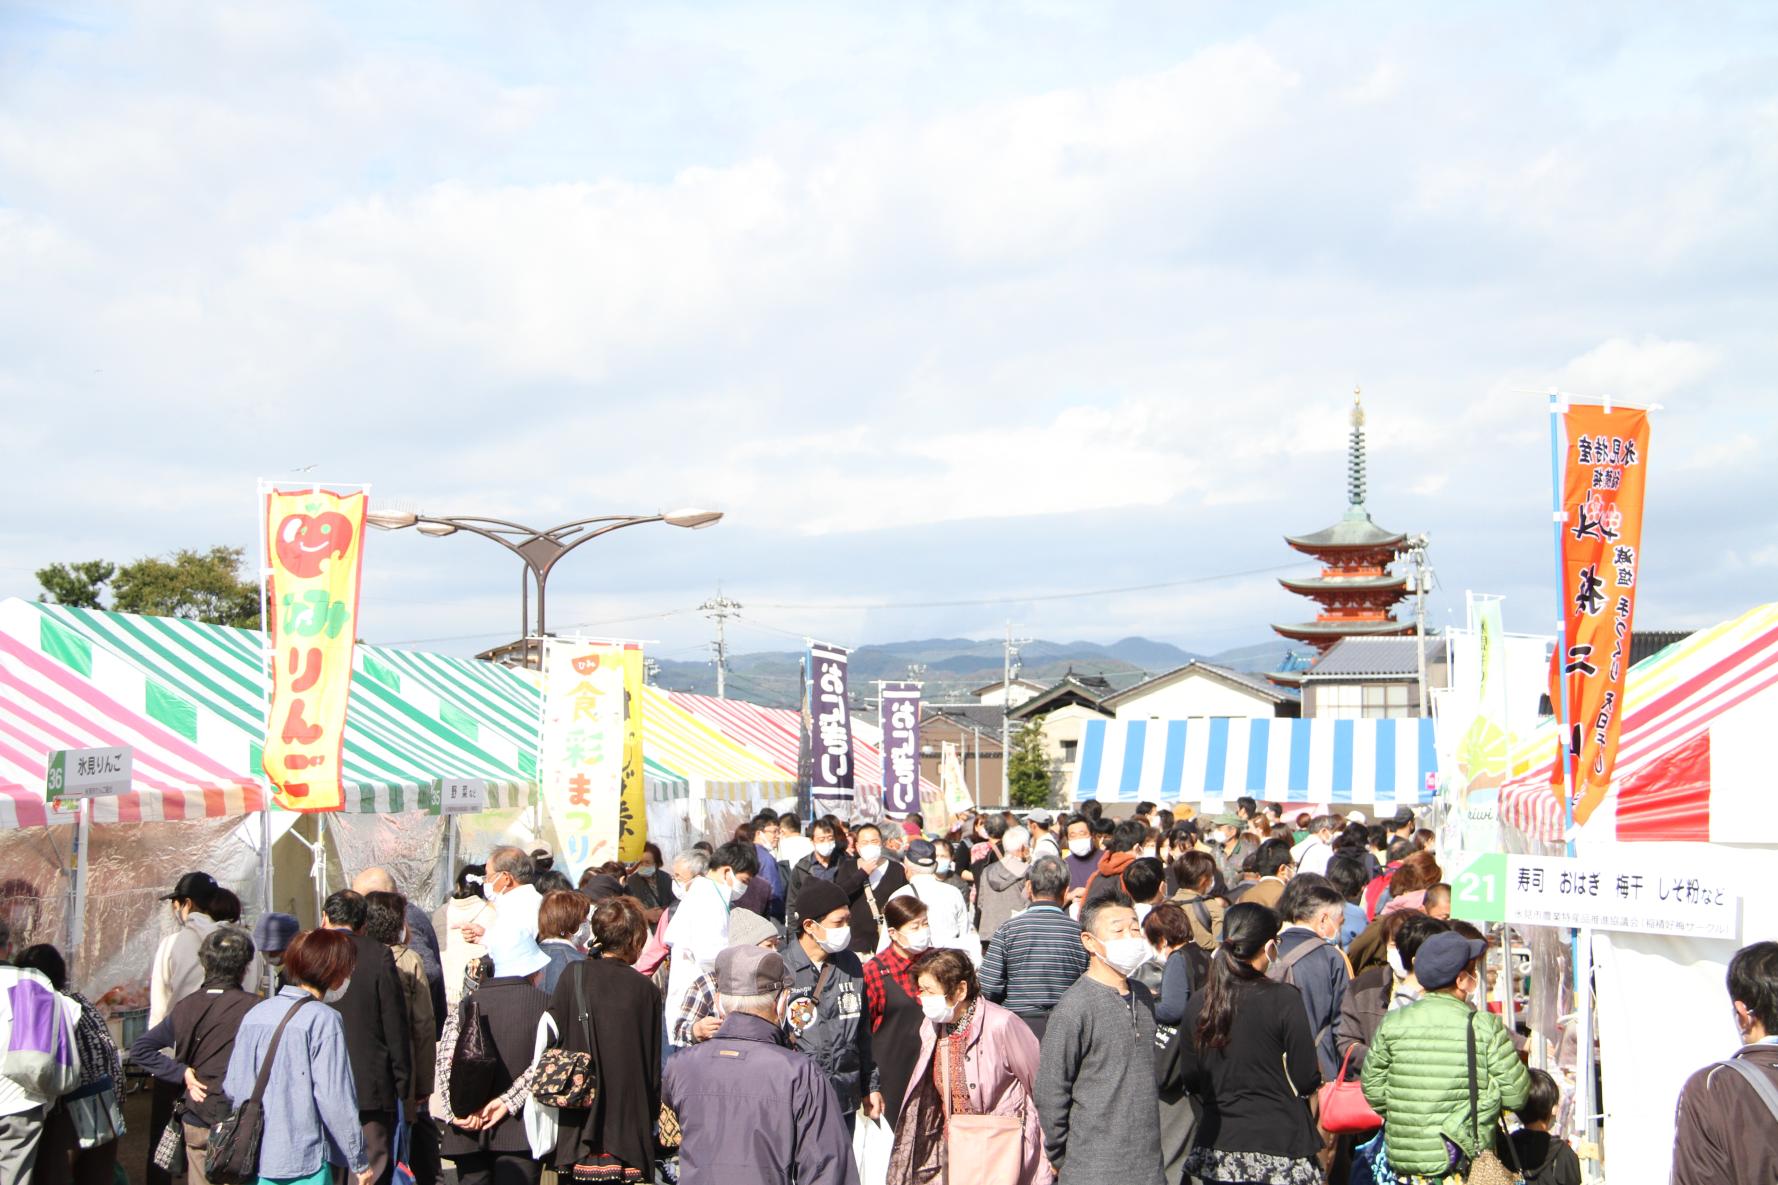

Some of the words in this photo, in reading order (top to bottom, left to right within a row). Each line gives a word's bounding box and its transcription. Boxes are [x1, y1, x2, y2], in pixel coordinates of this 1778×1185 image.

[48, 767, 63, 790] 36
[77, 753, 122, 777] 氷見りんご
[563, 680, 606, 865] 食彩まつり
[432, 790, 441, 806] 35
[1458, 872, 1496, 903] 21
[1517, 867, 1545, 894] 寿司
[1559, 869, 1601, 897] おはぎ
[1615, 873, 1644, 900] 梅干
[1657, 876, 1725, 906] しそ粉など
